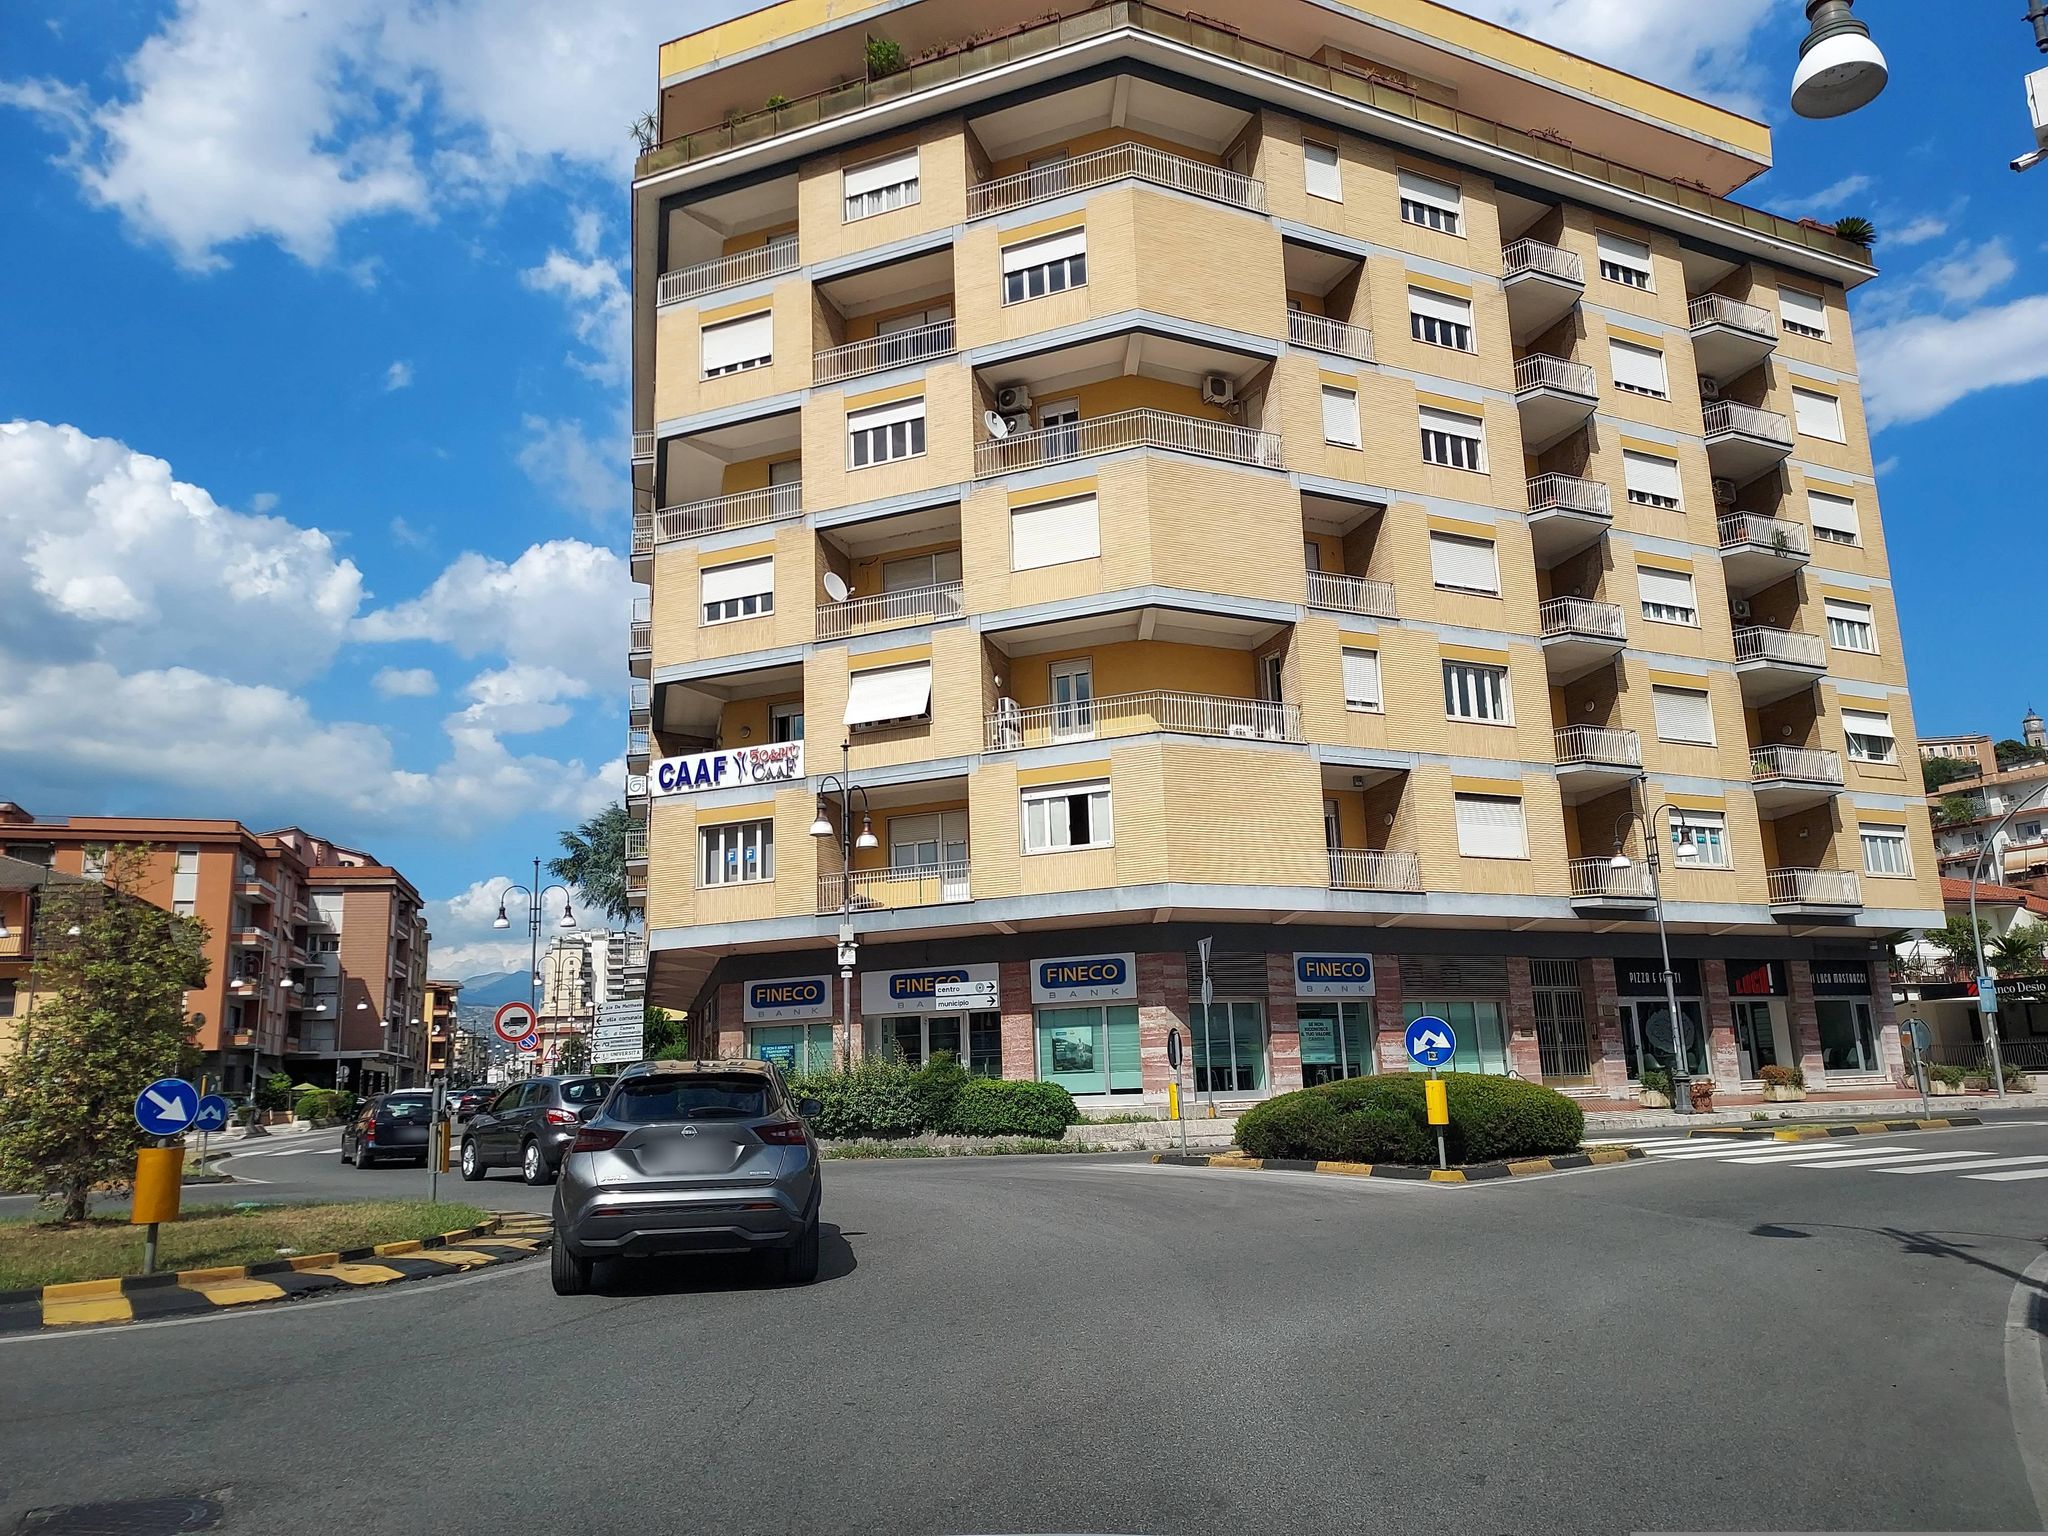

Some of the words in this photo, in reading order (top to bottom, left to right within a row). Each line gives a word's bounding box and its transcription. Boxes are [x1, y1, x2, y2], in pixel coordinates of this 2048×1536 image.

[659, 755, 728, 791] CAAF
[1046, 964, 1118, 983] FINECO
[1306, 962, 1366, 977] FINECO
[1629, 972, 1650, 984] PIZZA
[1306, 985, 1366, 993] BANK
[2016, 980, 2047, 993] Desio
[756, 986, 818, 1003] FINECO
[1049, 988, 1119, 999] BANK
[938, 1000, 969, 1008] municipio
[758, 1007, 818, 1018] BANK
